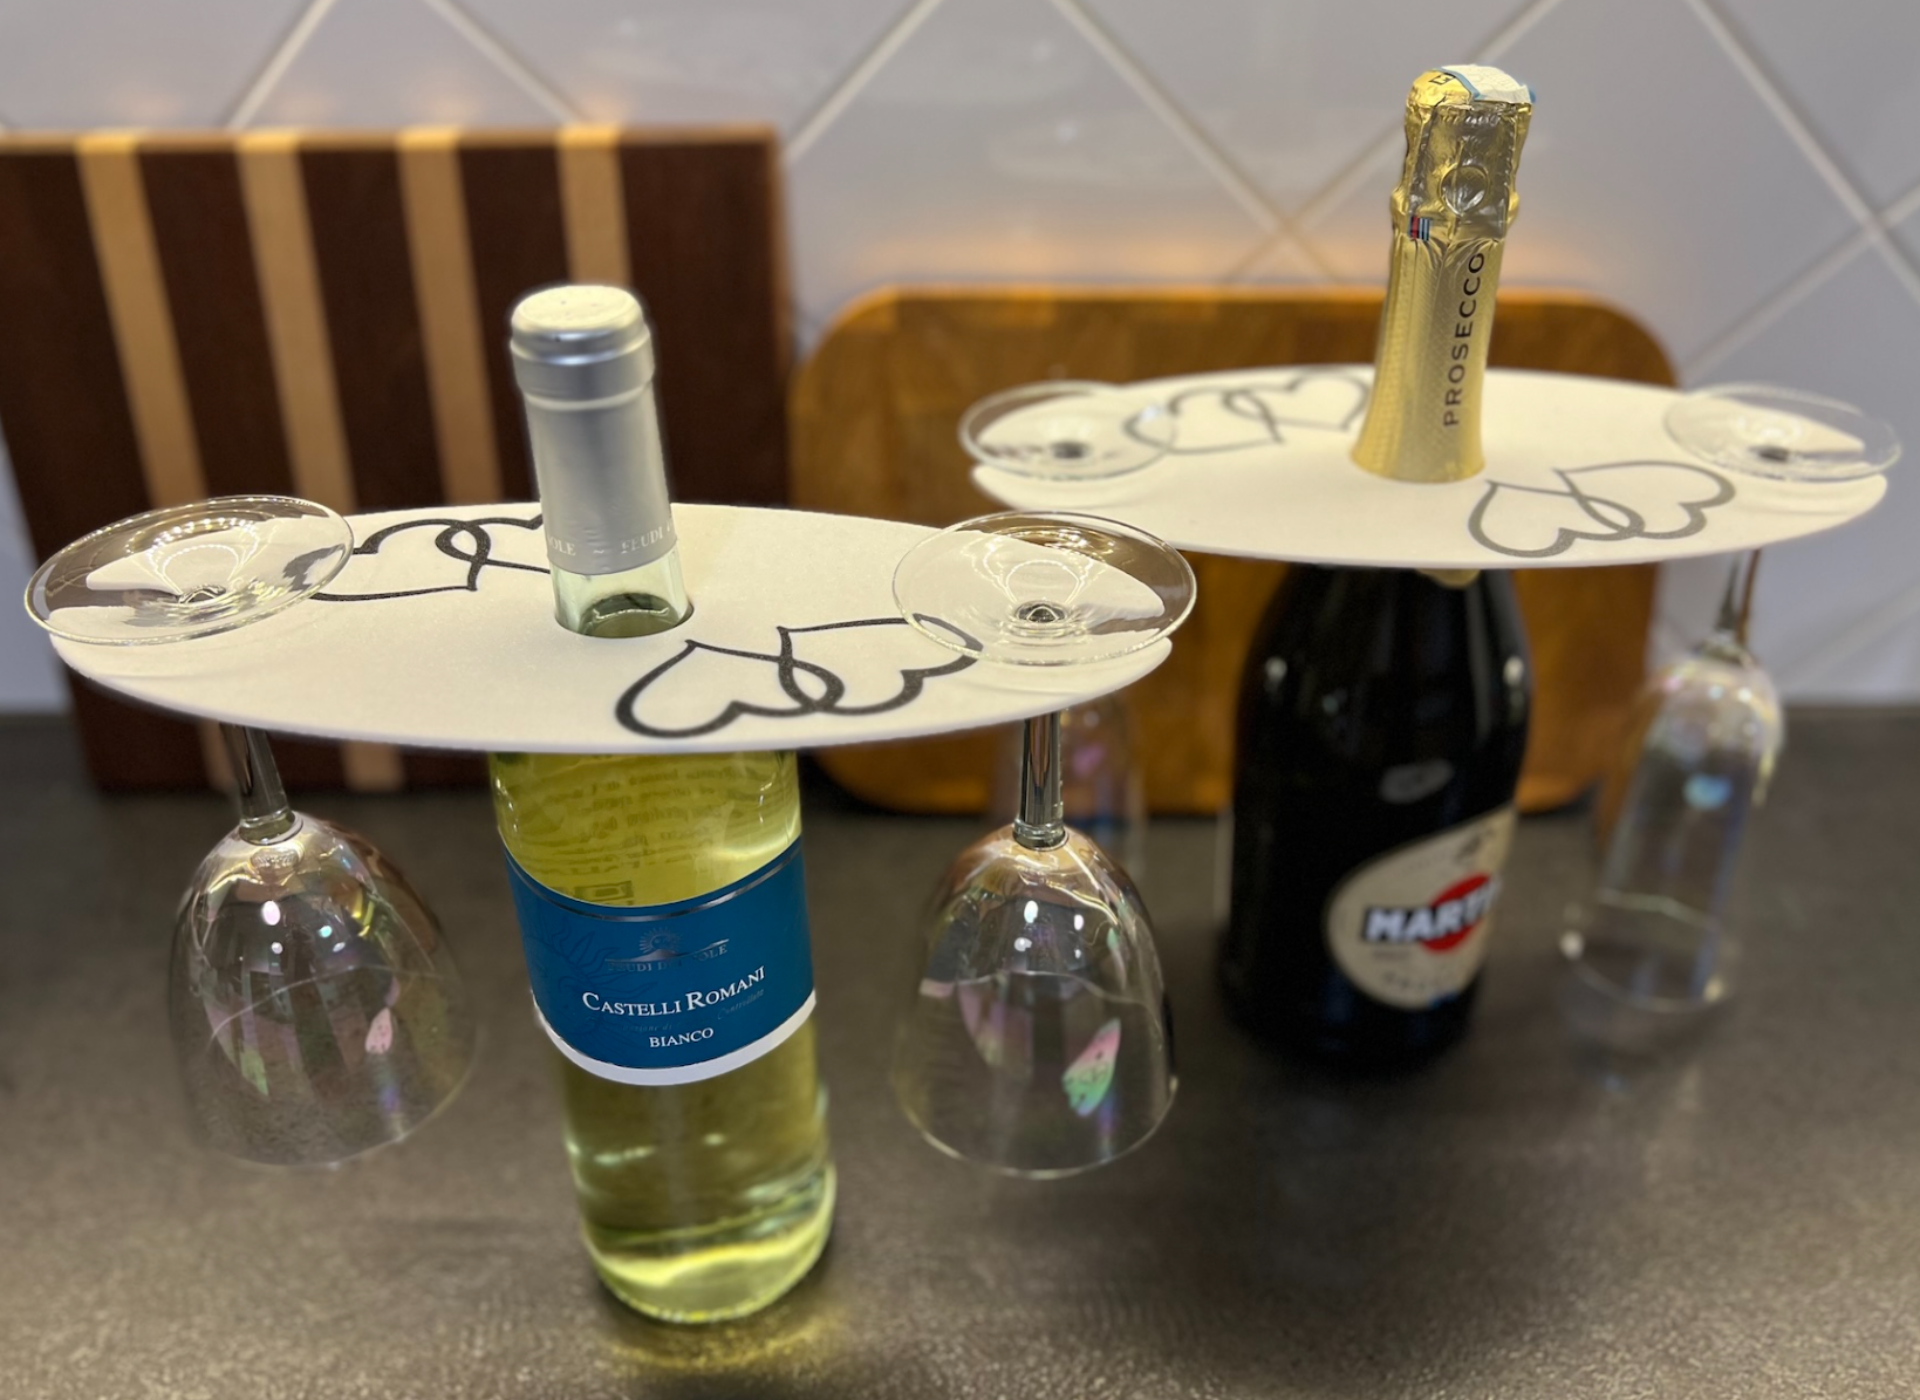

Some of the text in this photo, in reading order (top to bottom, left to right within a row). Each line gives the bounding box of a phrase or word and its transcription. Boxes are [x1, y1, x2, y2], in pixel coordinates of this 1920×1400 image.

[1443, 252, 1485, 427] PROSECCO
[621, 526, 664, 555] FEUDI
[582, 965, 766, 1017] CASTELLI ROMANI
[649, 1026, 715, 1048] BIANCO
